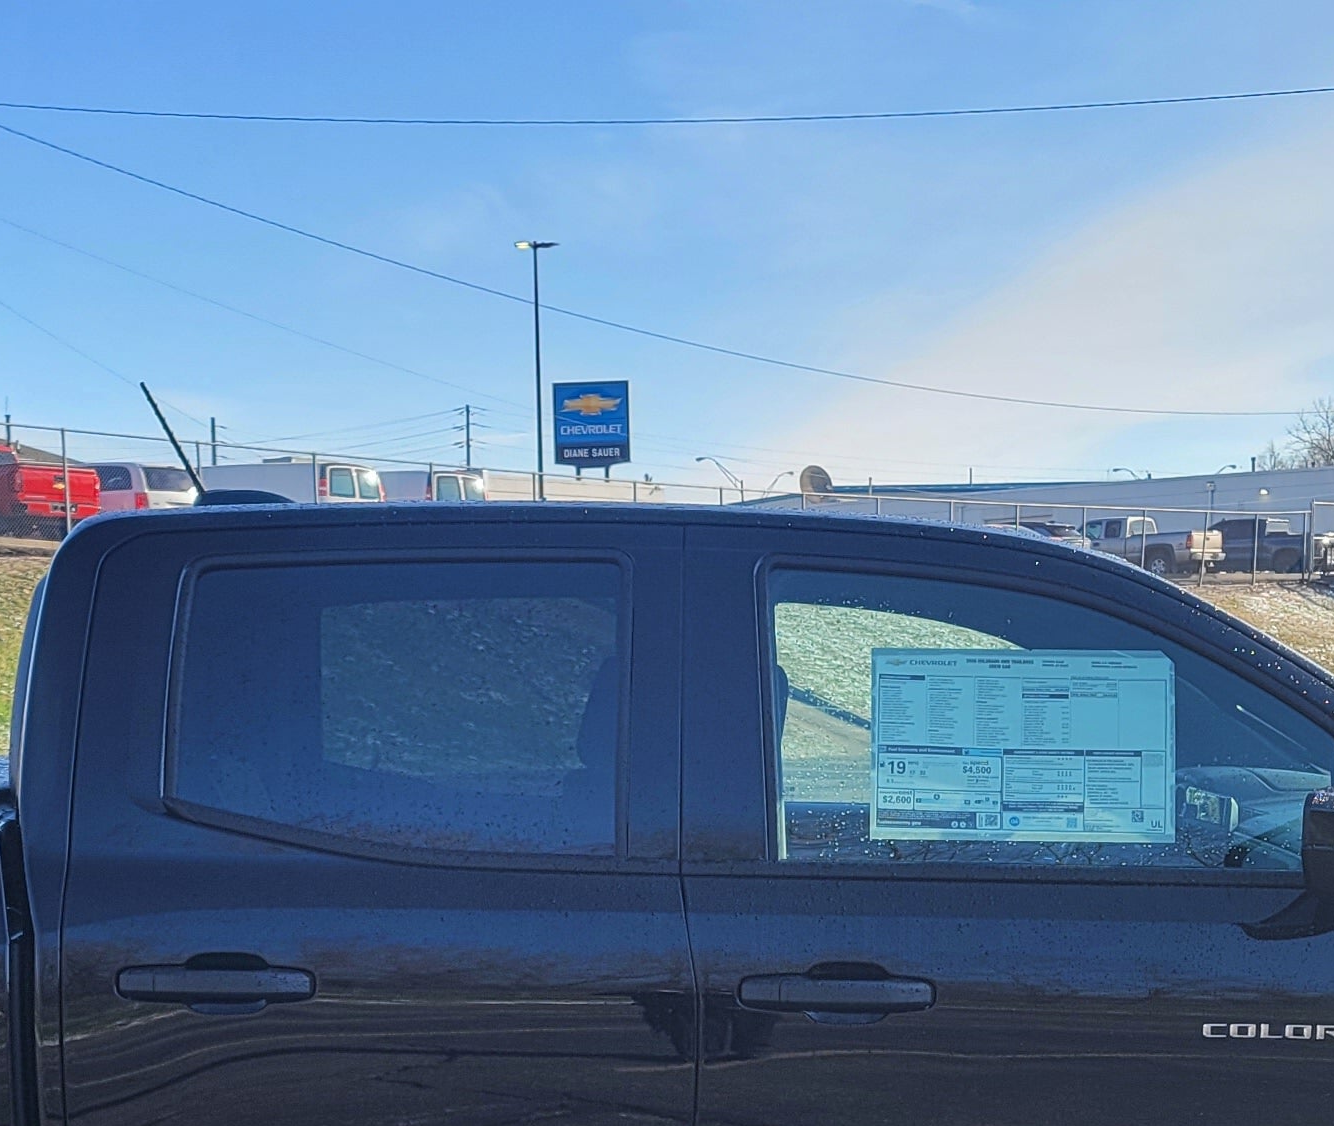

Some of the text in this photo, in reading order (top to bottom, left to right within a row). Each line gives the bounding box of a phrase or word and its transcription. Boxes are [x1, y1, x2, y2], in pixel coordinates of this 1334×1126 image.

[560, 424, 622, 435] CHEVROLET
[563, 447, 620, 458] DIANE SAUER
[909, 659, 957, 667] CHEVROLET
[887, 760, 906, 775] 19
[962, 766, 992, 775] $4,500
[1151, 820, 1163, 829] UL
